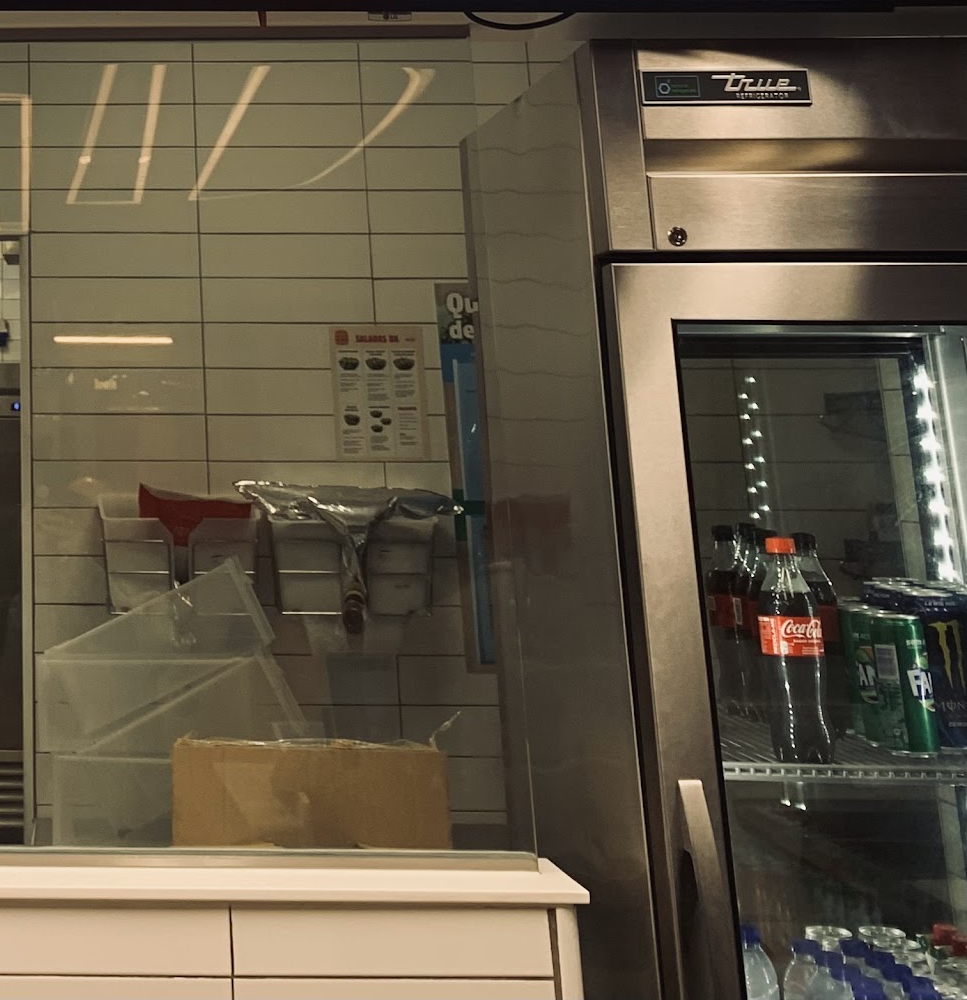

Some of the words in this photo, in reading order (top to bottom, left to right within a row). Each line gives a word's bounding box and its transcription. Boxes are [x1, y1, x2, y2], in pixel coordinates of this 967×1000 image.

[736, 92, 790, 100] REFRIGERATOR
[446, 292, 478, 319] Qu
[907, 669, 932, 697] FA
